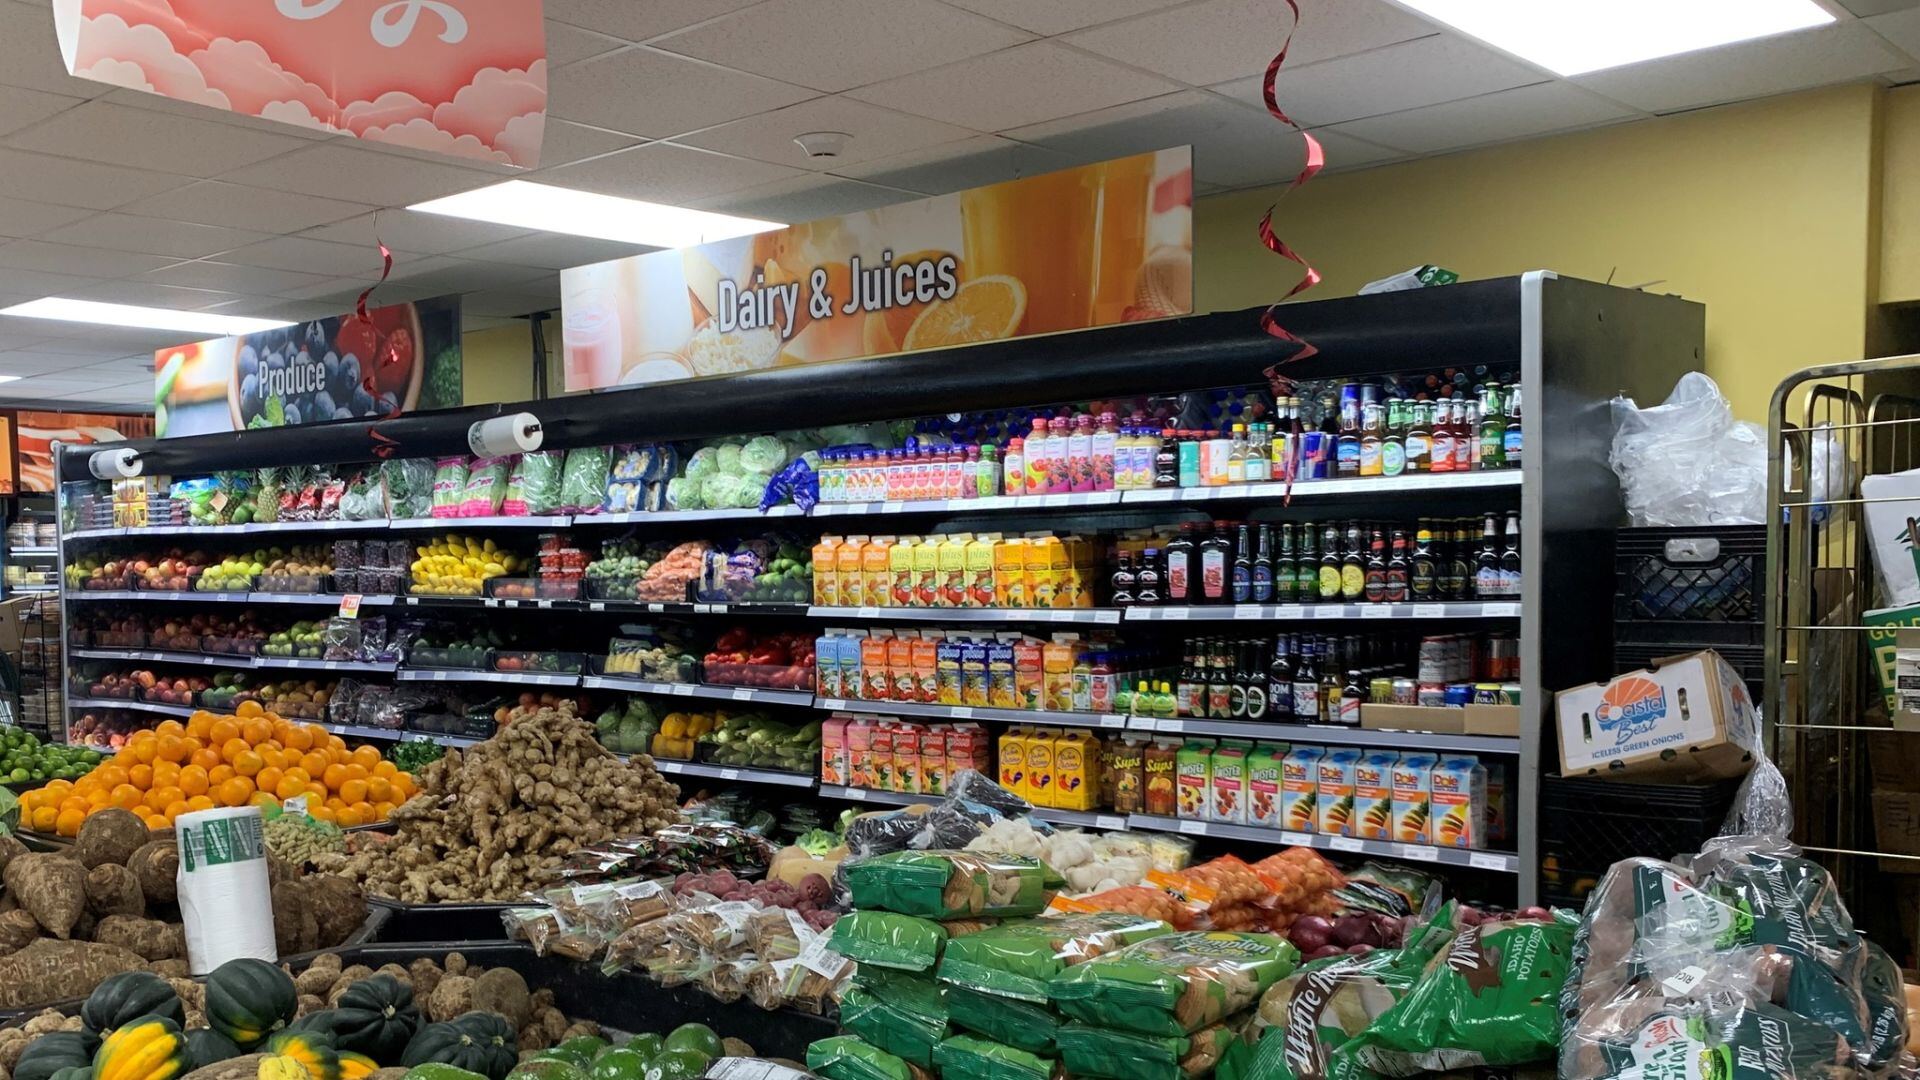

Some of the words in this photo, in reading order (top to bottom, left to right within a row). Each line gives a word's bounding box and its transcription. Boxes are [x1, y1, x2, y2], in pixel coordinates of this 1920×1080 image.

[718, 274, 799, 338] Dairy
[808, 268, 833, 319] &
[842, 251, 957, 315] Juices
[259, 355, 326, 399] Produce
[1595, 685, 1667, 723] Coastal
[1614, 715, 1658, 746] Best
[1592, 746, 1622, 760] ICELESS
[1622, 740, 1650, 753] GREEN
[1651, 732, 1685, 746] ONIONS
[1179, 763, 1205, 775] TWISTER
[1214, 765, 1241, 777] TWISTER
[1251, 768, 1278, 780] TWISTER
[1284, 764, 1306, 775] Dole
[1320, 767, 1344, 778] Dole
[1357, 769, 1380, 780] Dole
[1394, 772, 1418, 784] Dole
[1434, 775, 1459, 786] Dole
[1506, 935, 1526, 973] IDAHO
[1517, 927, 1543, 980] POTATOES
[1738, 1045, 1766, 1072] RED
